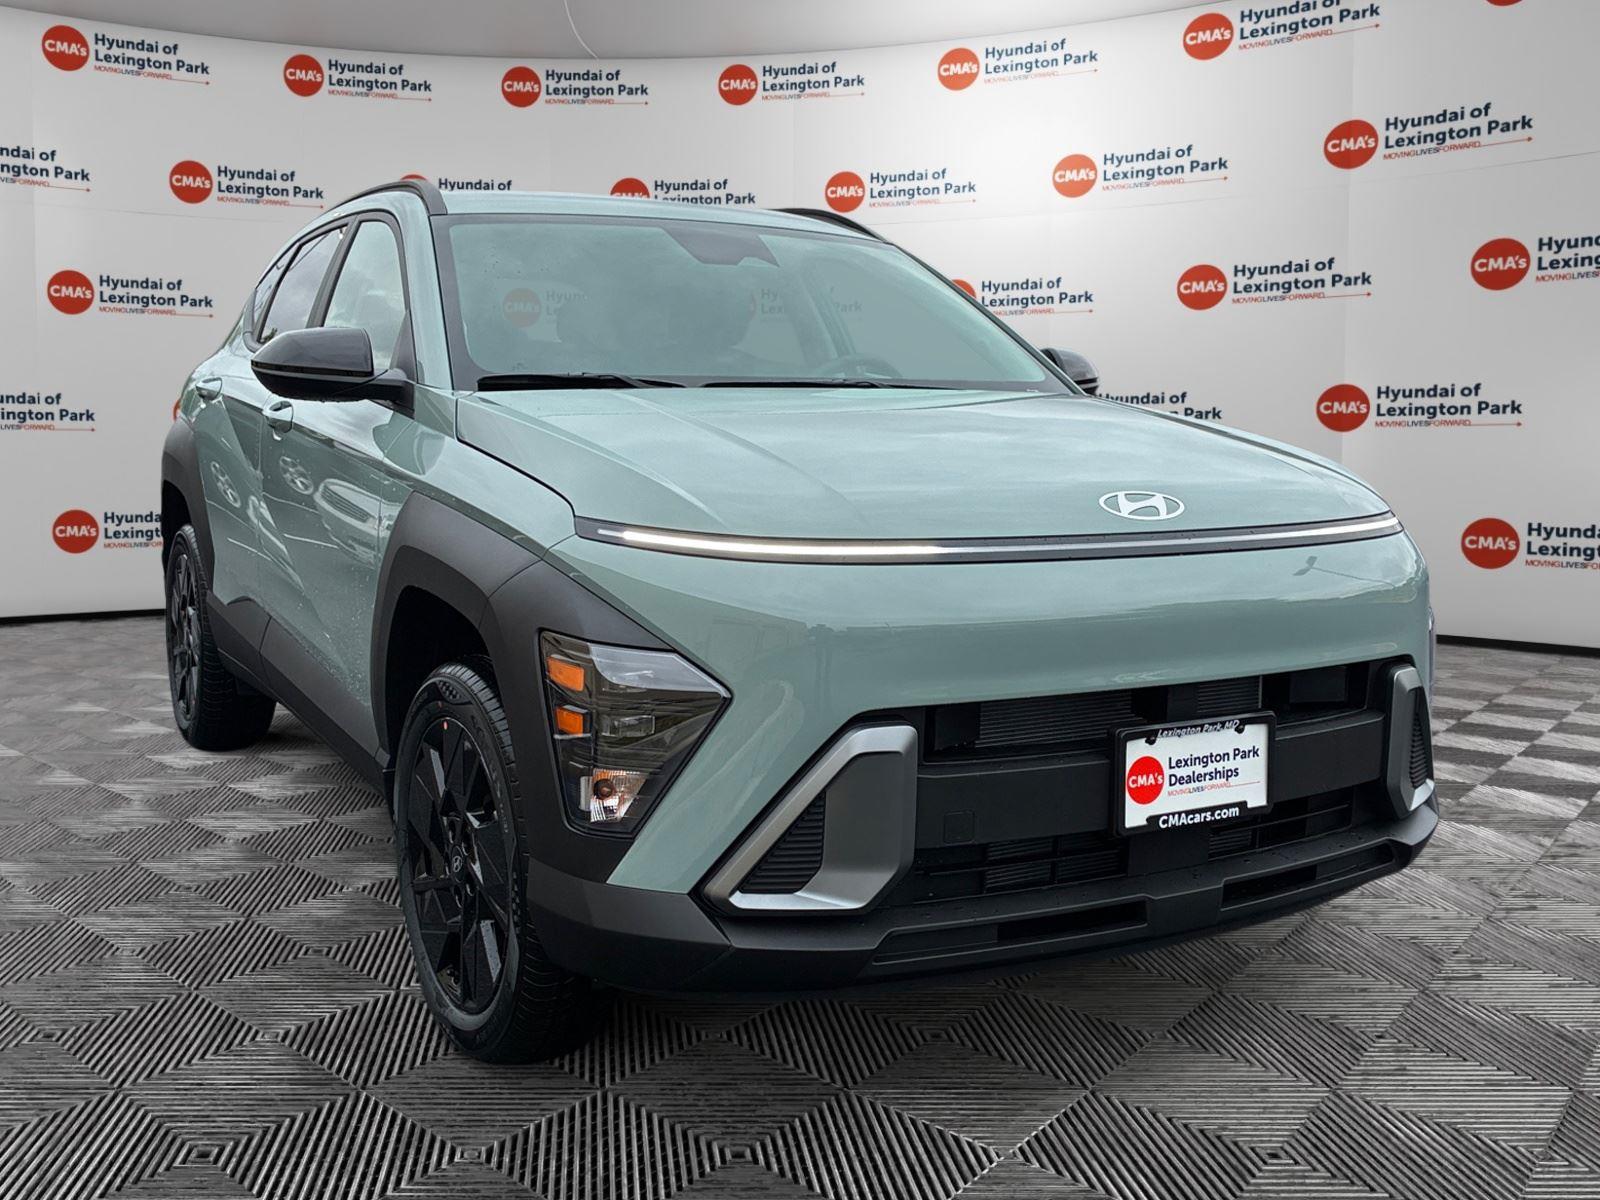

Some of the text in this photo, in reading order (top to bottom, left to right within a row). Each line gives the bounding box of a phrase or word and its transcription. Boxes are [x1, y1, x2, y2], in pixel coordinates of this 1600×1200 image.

[1240, 4, 1380, 40] Lexington Park
[94, 33, 178, 55] Hyundai of
[1185, 27, 1231, 45] CMA's
[45, 40, 87, 56] CMA's
[985, 37, 1066, 61] Hyundai of
[95, 49, 209, 74] Lexington Park
[328, 59, 403, 76] Hyundai of
[939, 61, 978, 76] CMA's
[985, 51, 1097, 74] Lexington Park
[286, 69, 322, 82] CMA's
[546, 69, 620, 86] Hyundai of
[762, 62, 836, 79] Hyundai of
[329, 74, 431, 92] Lexington Park
[504, 81, 539, 92] CMA's
[546, 84, 648, 98] Lexington Park
[720, 79, 756, 90] CMA's
[763, 75, 864, 93] Lexington Park
[1386, 102, 1491, 134] Hyundai of
[1385, 115, 1533, 152] Lexington Park
[1327, 135, 1375, 153] CMA's
[39, 150, 56, 162] of
[1103, 143, 1193, 168] Hyundai of
[54, 166, 90, 181] Park
[218, 166, 295, 182] Hyundai of
[870, 168, 946, 185] Hyundai of
[1055, 167, 1095, 183] CMA's
[1104, 157, 1228, 181] Lexington Park
[172, 175, 211, 188] CMA's
[218, 181, 323, 199] Lexington Park
[439, 178, 512, 191] Hyundai of
[655, 179, 728, 194] Hyundai of
[726, 193, 755, 204] Park
[826, 185, 864, 199] CMA's
[870, 182, 976, 199] Lexington Park
[1234, 257, 1335, 280] Hyundai of
[1475, 256, 1527, 272] CMA's
[50, 285, 92, 298] CMA's
[100, 275, 182, 291] Hyundai of
[982, 277, 1061, 293] Hyundai of
[1179, 280, 1225, 294] CMA's
[1233, 272, 1371, 294] Lexington Park
[100, 291, 212, 308] Lexington Park
[982, 291, 1093, 308] Lexington Park
[45, 393, 61, 405] of
[1169, 392, 1187, 404] of
[1377, 383, 1481, 402] Hyundai of
[59, 409, 95, 421] Park
[1184, 407, 1221, 420] Park
[1320, 401, 1367, 414] CMA's
[1377, 400, 1522, 419] Lexington Park
[55, 525, 96, 537] CMA's
[1465, 536, 1516, 550] CMA's
[1158, 726, 1202, 738] Lexington
[1224, 720, 1240, 729] MD
[1169, 746, 1259, 769] Lexington Park
[1128, 772, 1163, 788] CMA's
[1169, 766, 1239, 787] Dealerships
[1159, 807, 1239, 829] CMAcars.com
